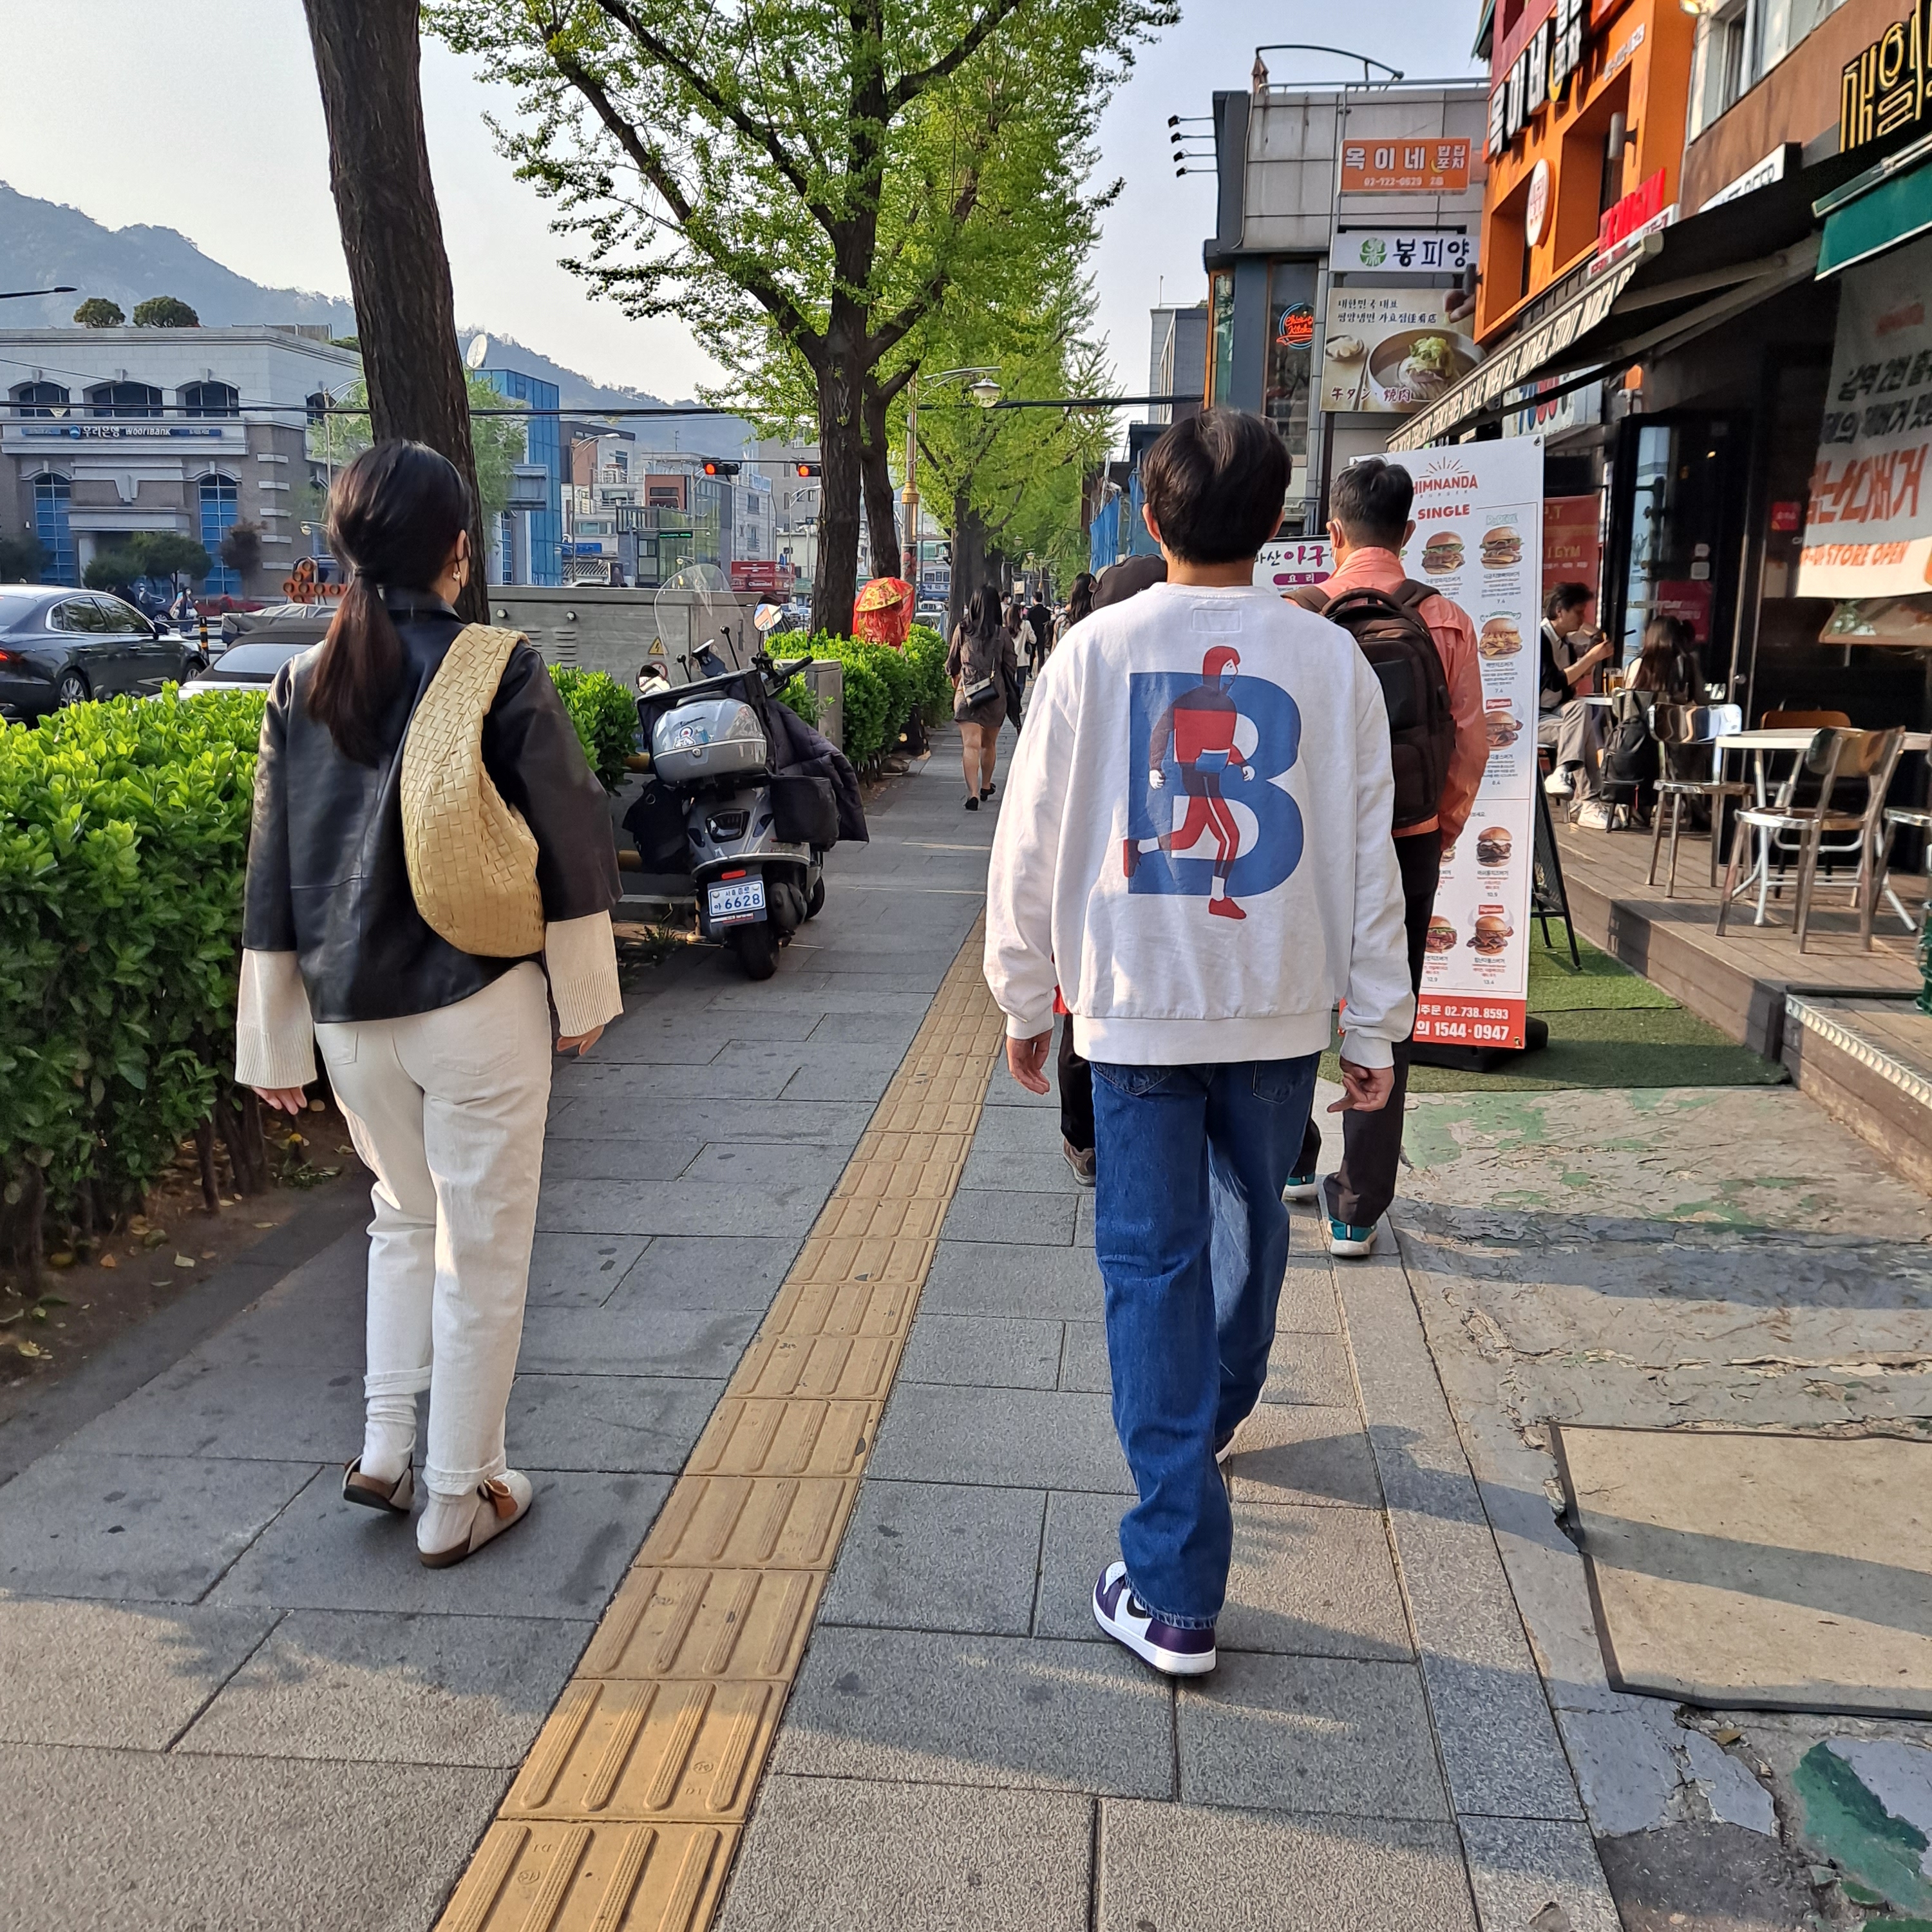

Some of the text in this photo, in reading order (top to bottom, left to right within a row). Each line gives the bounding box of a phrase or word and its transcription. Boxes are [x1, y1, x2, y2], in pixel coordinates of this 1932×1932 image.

[1345, 146, 1426, 170] 옥이네
[1392, 238, 1470, 268] 봉피양
[1417, 504, 1470, 520] SINGLE
[1287, 573, 1314, 583] 요리
[1128, 672, 1304, 897] B
[724, 893, 760, 909] 6628
